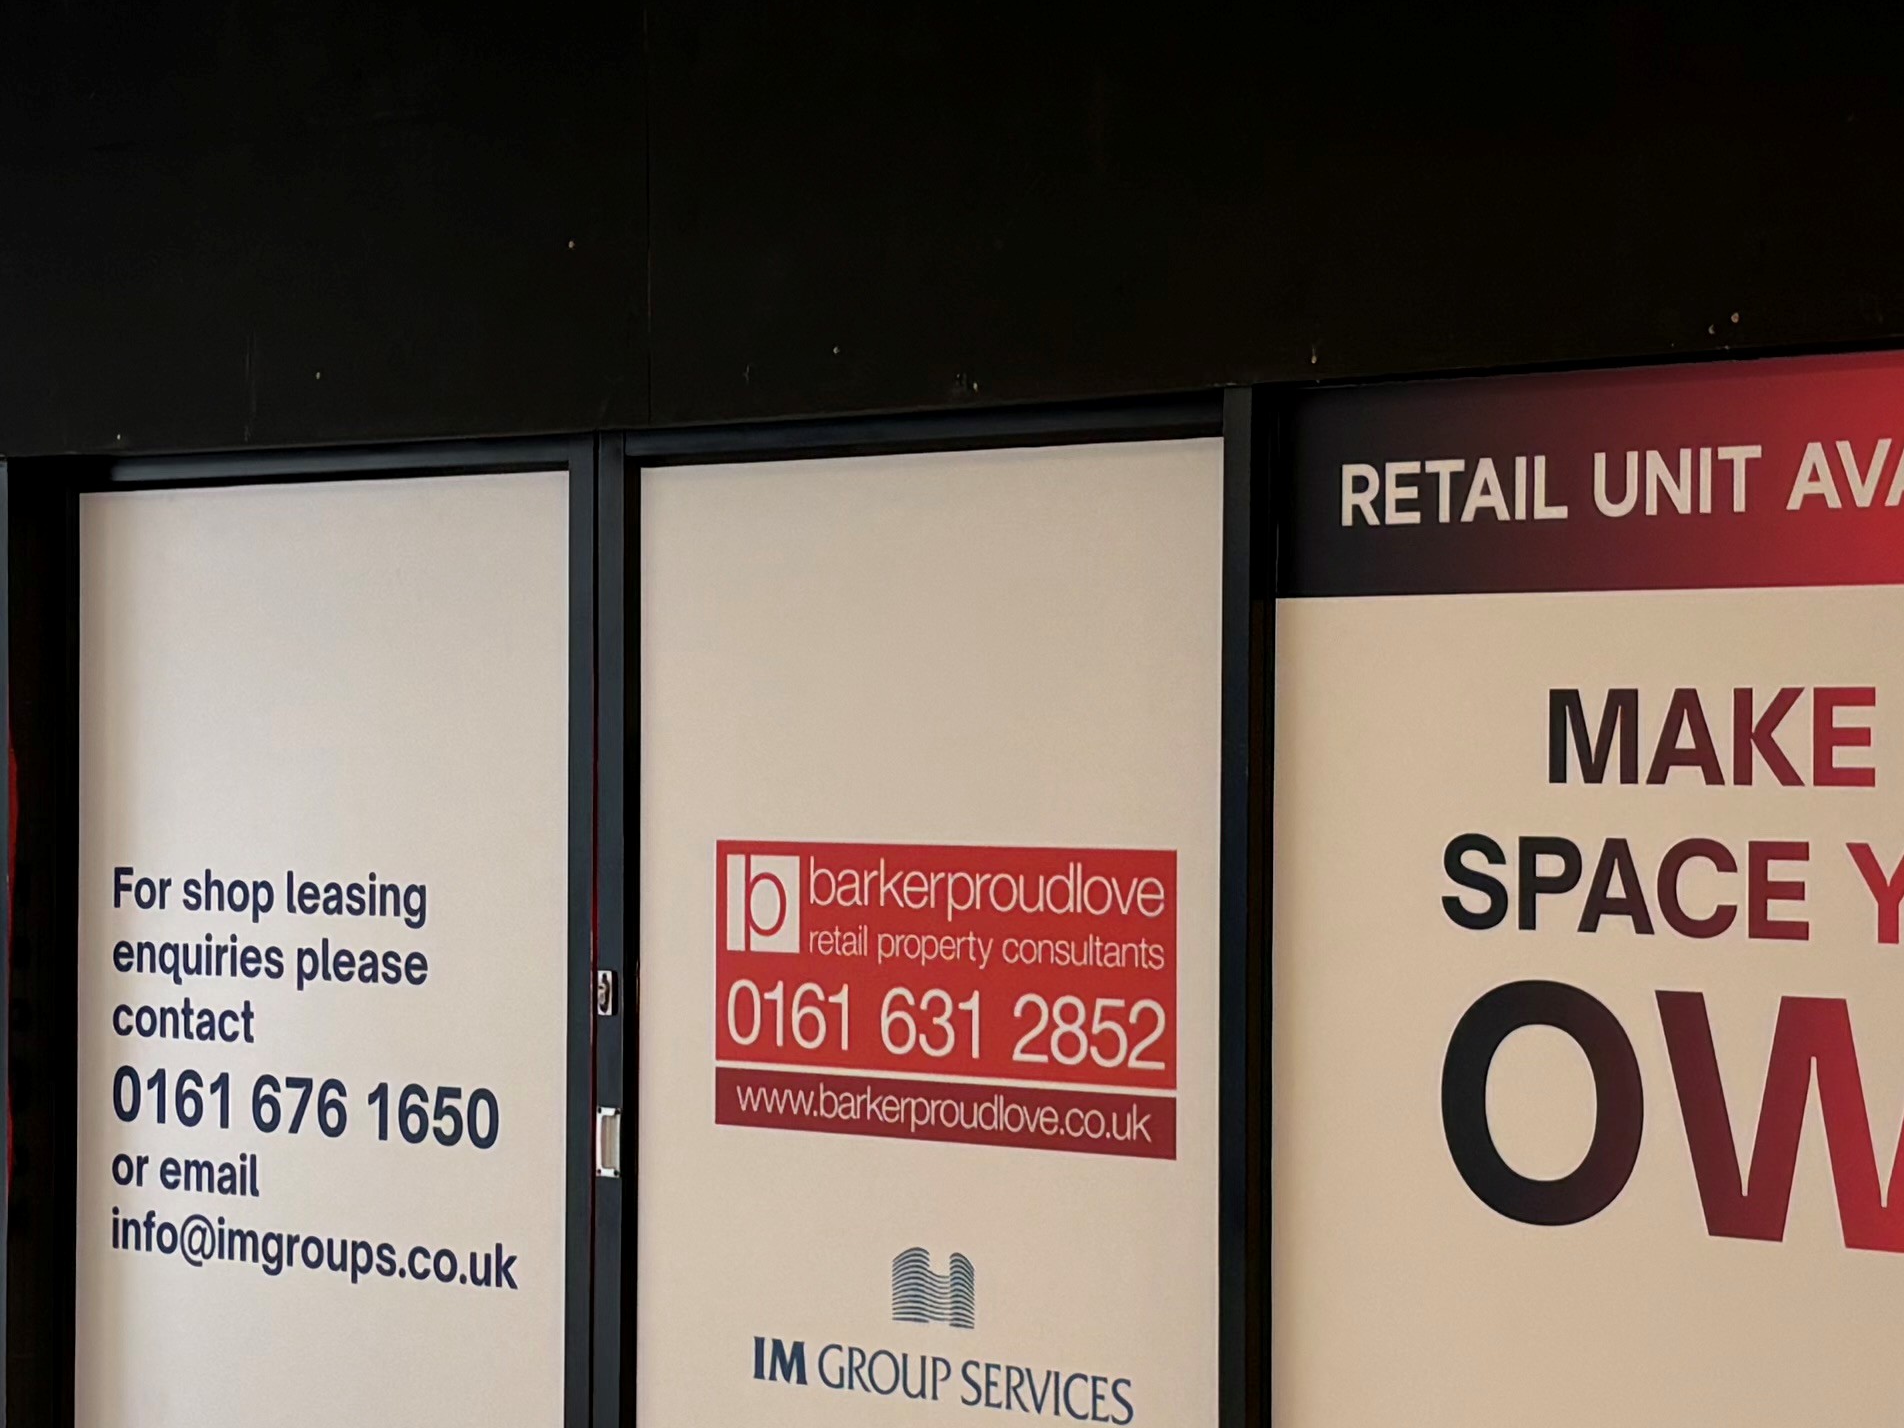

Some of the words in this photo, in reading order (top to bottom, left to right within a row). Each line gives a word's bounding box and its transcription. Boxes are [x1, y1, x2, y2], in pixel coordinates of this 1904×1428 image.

[1342, 456, 1568, 526] RETAIL
[1594, 445, 1761, 517] UNIT
[1548, 686, 1876, 788] MAKE
[113, 866, 172, 910] For
[182, 868, 275, 923] shop
[286, 870, 427, 929] leasing
[809, 856, 1165, 921] barkerproudlove
[1441, 833, 1810, 941] SPACE
[112, 933, 284, 985] enquiries
[296, 937, 429, 991] please
[809, 925, 868, 957] retail
[877, 931, 994, 970] property
[1001, 933, 1165, 971] consultants
[112, 997, 255, 1044] contact
[727, 979, 849, 1051] 0161
[880, 986, 980, 1059] 631
[1012, 993, 1166, 1070] 2852
[112, 1065, 230, 1129] 0161
[252, 1074, 348, 1138] 676
[367, 1083, 500, 1150] 1650
[736, 1083, 1152, 1143] www.barkerproudlove.co.uk
[111, 1153, 149, 1187] or
[159, 1153, 260, 1198] email
[111, 1206, 518, 1290] info@imgroups.co.uk
[753, 1335, 808, 1386] IM
[817, 1343, 952, 1401] GROUP
[960, 1359, 1134, 1426] SERVICES
